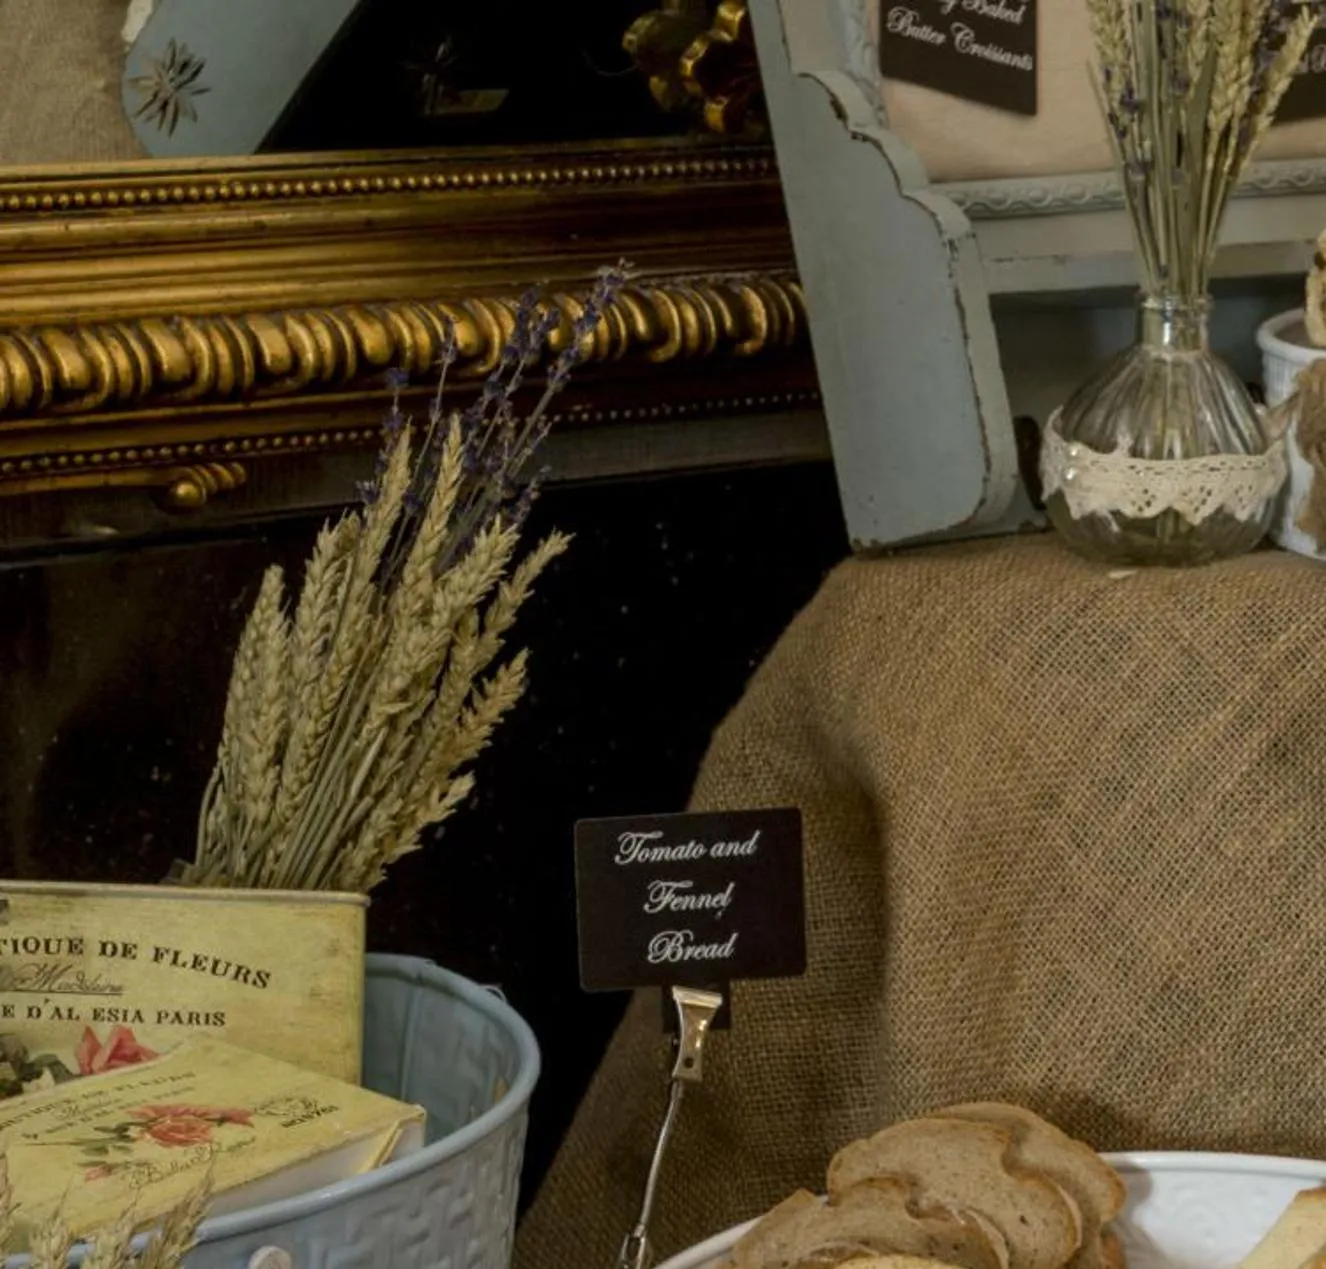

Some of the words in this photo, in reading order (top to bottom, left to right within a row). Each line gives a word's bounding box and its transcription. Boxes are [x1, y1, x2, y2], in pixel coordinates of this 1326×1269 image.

[614, 830, 707, 866] Tomato
[709, 829, 761, 858] and
[643, 880, 735, 913] Fennel
[647, 929, 739, 963] Bread
[98, 940, 139, 960] DE
[152, 946, 272, 990] FLEURS
[92, 1007, 145, 1024] ESIA
[156, 1009, 227, 1027] PARIS
